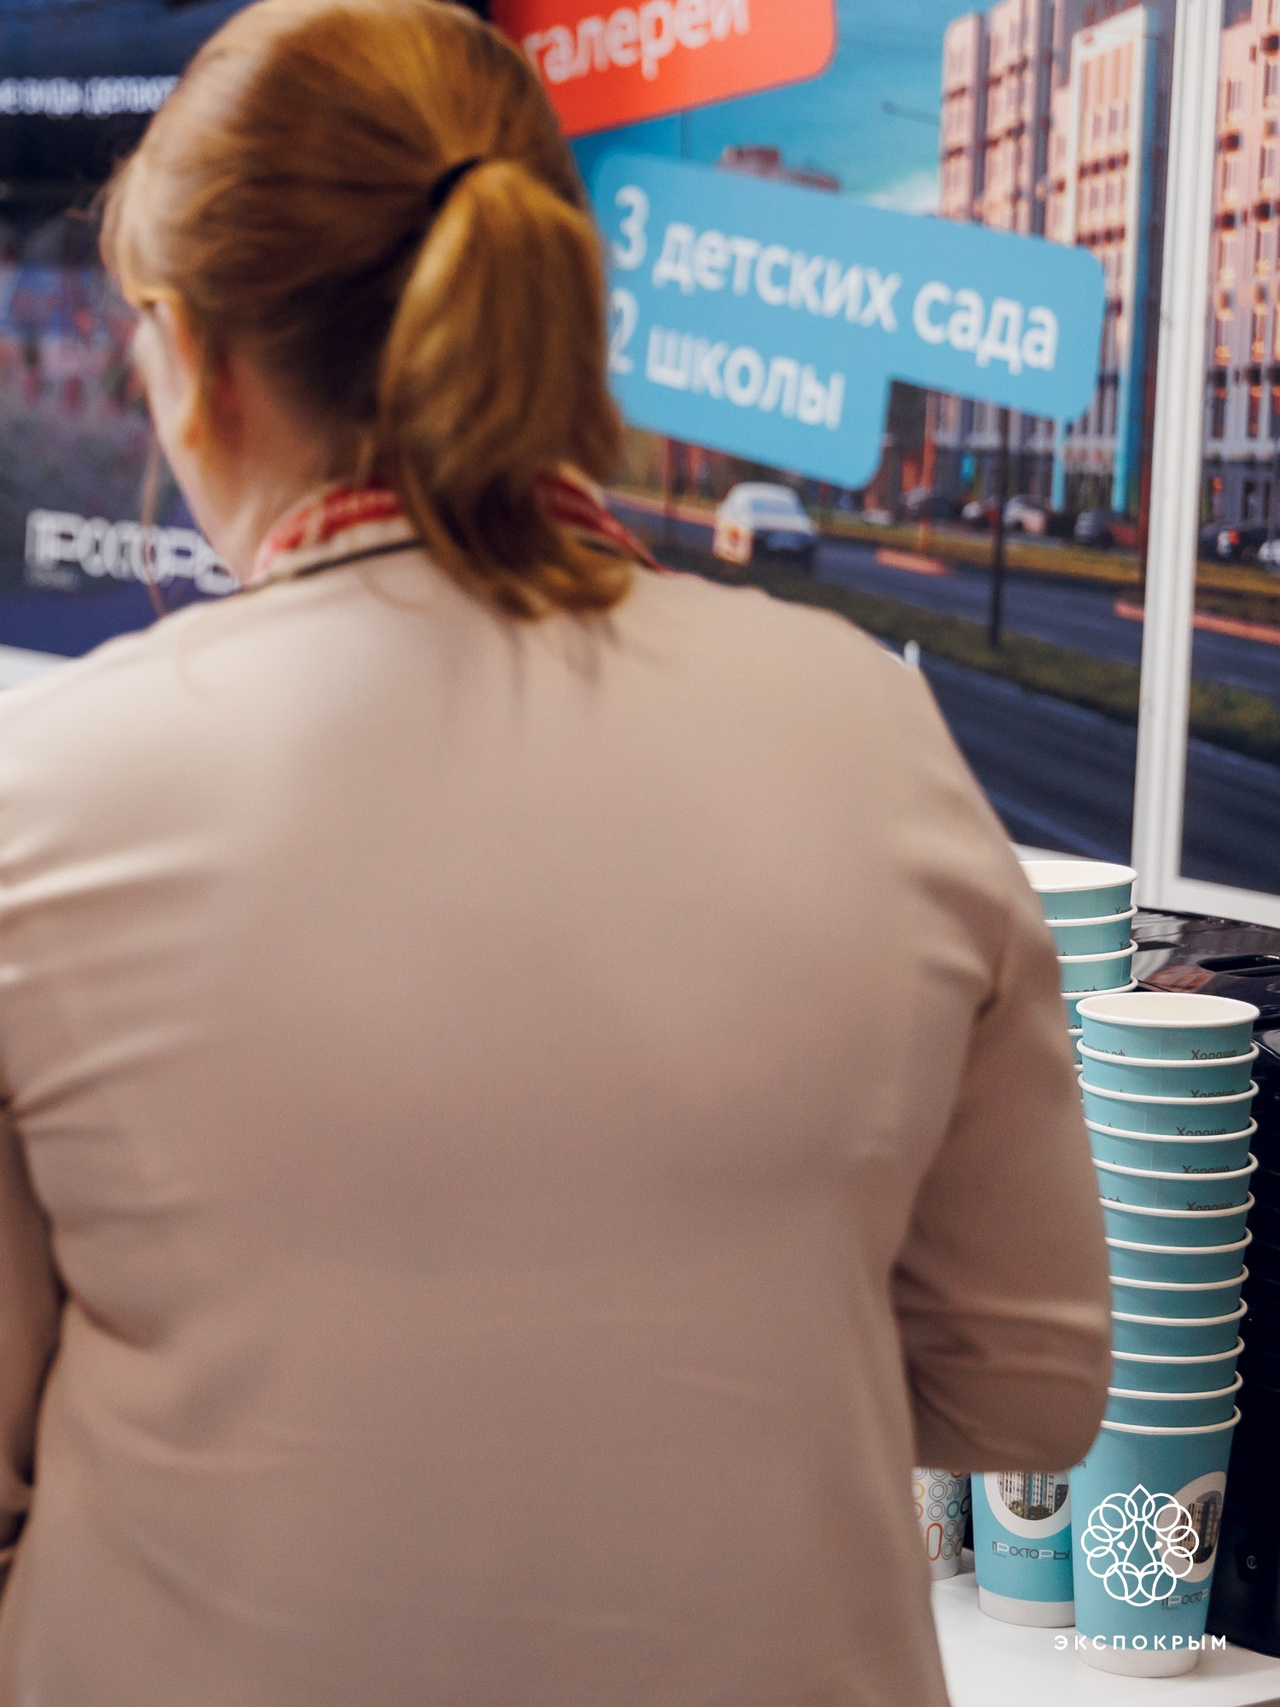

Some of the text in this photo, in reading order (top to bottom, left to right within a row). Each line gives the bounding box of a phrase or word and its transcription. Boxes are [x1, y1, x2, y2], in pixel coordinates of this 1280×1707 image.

[608, 288, 847, 429] 2 школы
[611, 184, 1059, 374] 3 детских сада
